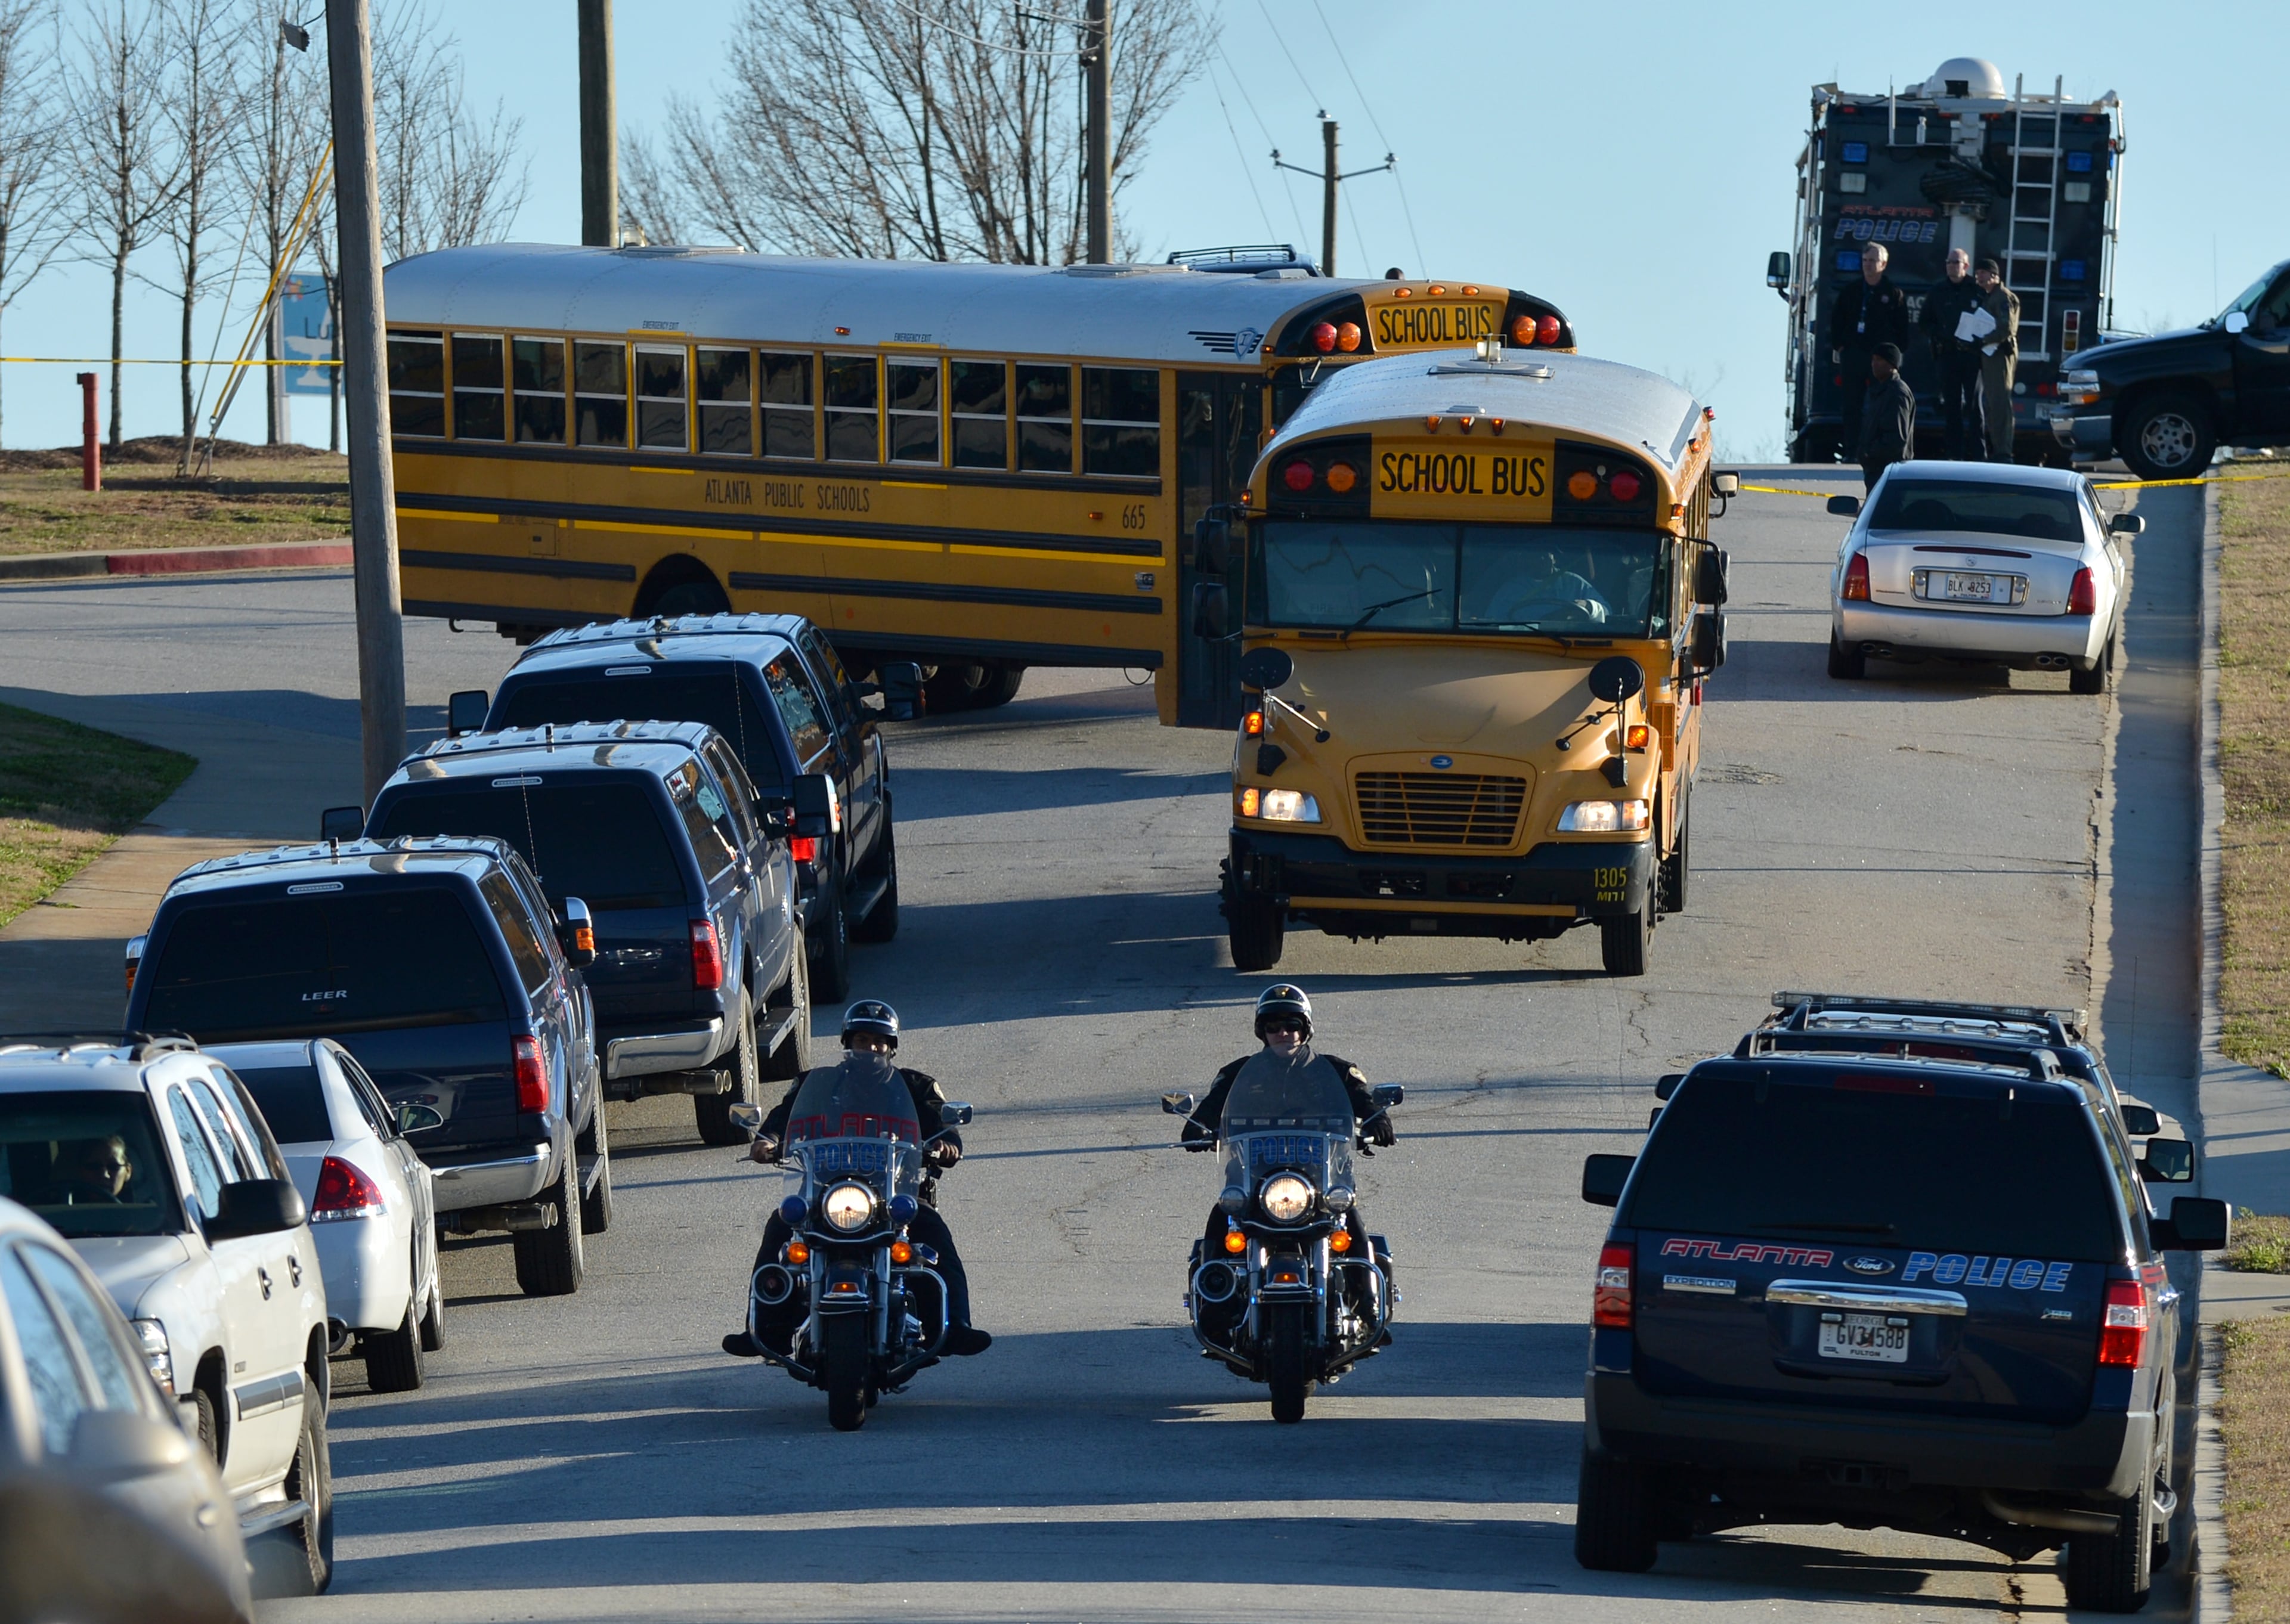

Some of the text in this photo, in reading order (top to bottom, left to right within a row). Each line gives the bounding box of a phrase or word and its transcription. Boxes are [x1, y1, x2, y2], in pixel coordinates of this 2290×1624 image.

[1841, 205, 1934, 217] ATLANTA
[1834, 218, 1938, 243] POLICE
[642, 320, 669, 330] EMERGENCY
[894, 332, 921, 342] EMERGENCY
[1379, 305, 1492, 344] SCHOOL BUS
[1380, 453, 1545, 497] SCHOOL BUS
[705, 479, 870, 512] ATLANTA PUBLIC SCHOOLS
[1122, 504, 1145, 530] 665
[1948, 579, 1964, 592] BLK
[1594, 867, 1627, 888] 1305
[302, 990, 347, 1001] LEER
[787, 1112, 920, 1145] ATLANTA
[815, 1143, 887, 1173] POLICE
[1251, 1136, 1323, 1165] POLICE
[1660, 1238, 1834, 1268] ATLANTA
[1853, 1257, 1884, 1271] Ford
[1666, 1275, 1736, 1288] EXPEDITION
[1901, 1251, 2073, 1292] POLICE
[1849, 1349, 1881, 1357] FULTON
